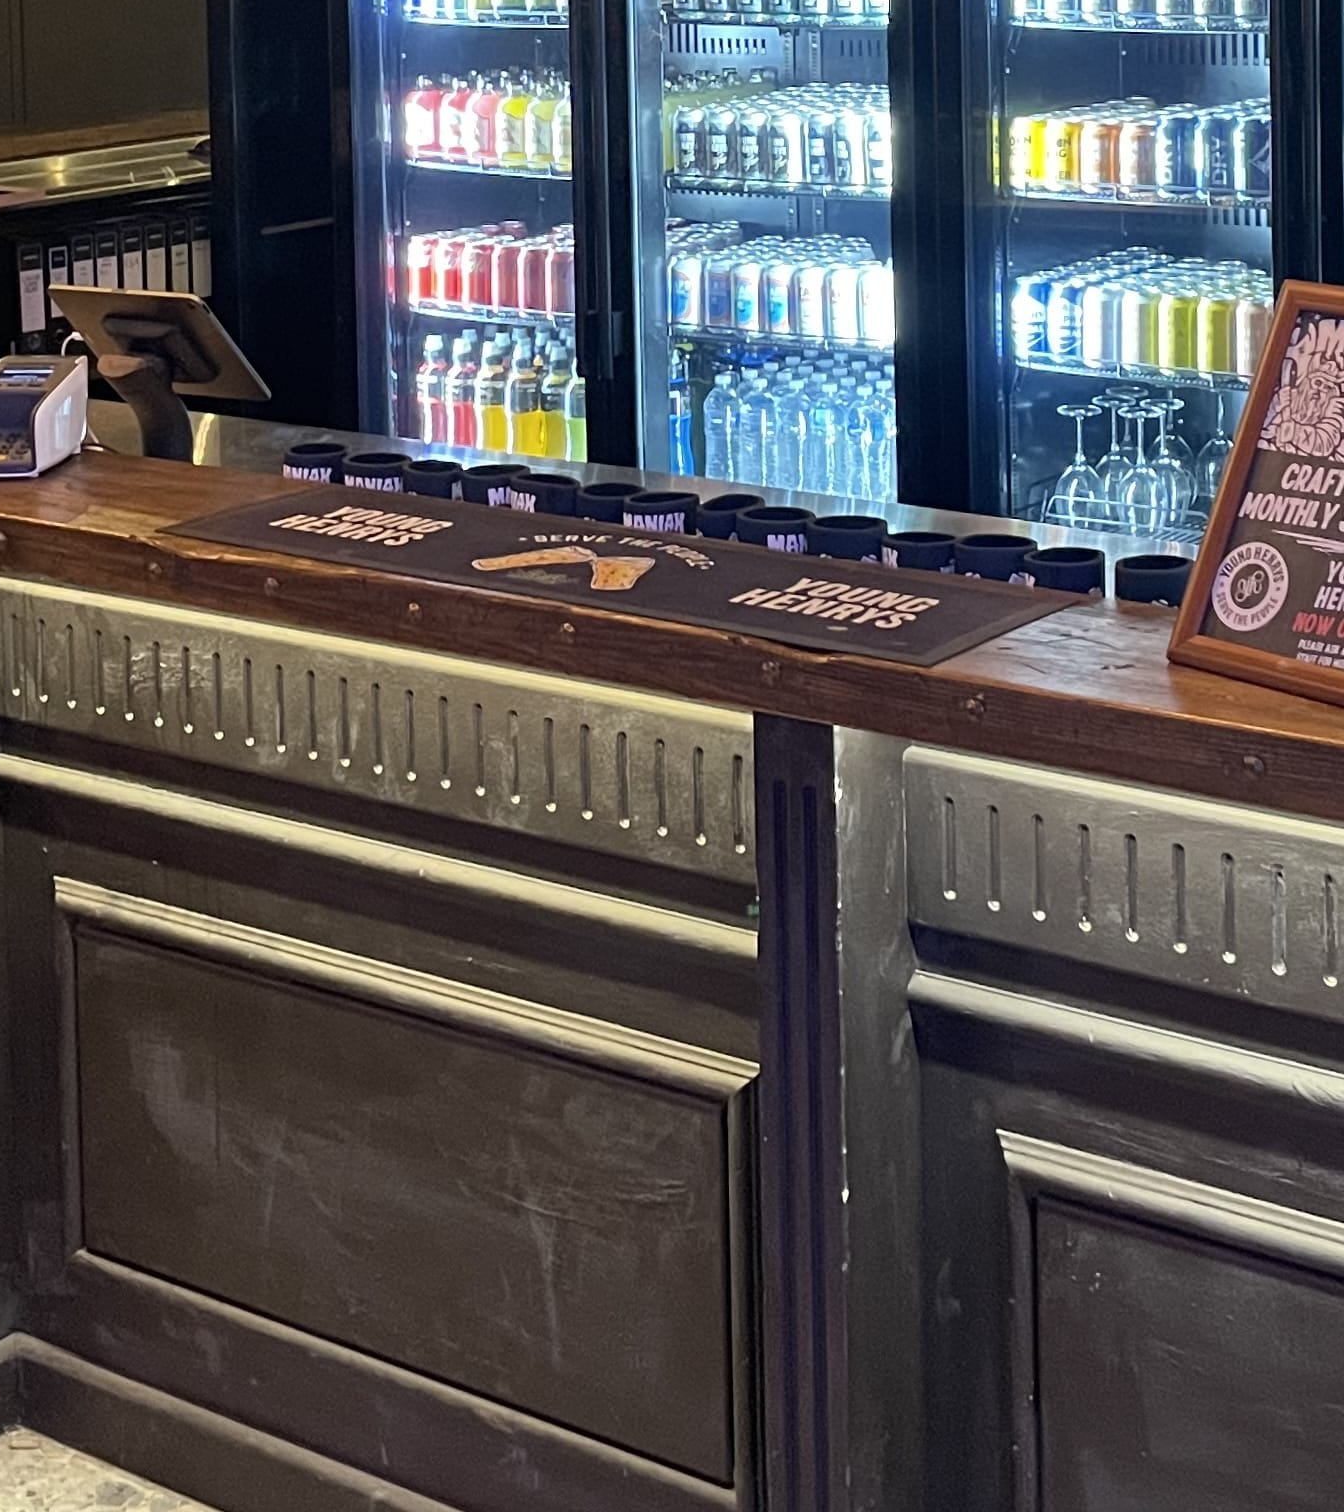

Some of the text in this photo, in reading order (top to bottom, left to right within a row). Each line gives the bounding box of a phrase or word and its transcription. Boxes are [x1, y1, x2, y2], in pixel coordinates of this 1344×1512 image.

[324, 505, 454, 534] YOUNG
[1238, 492, 1341, 530] MONTHLY
[269, 514, 424, 546] HENRYS
[729, 588, 918, 629] HENRYS
[783, 577, 940, 614] YOUNG
[1292, 611, 1336, 636] NOW
[1297, 638, 1325, 652] PLEASE
[1324, 643, 1341, 655] ASK
[1317, 655, 1332, 666] FOR
